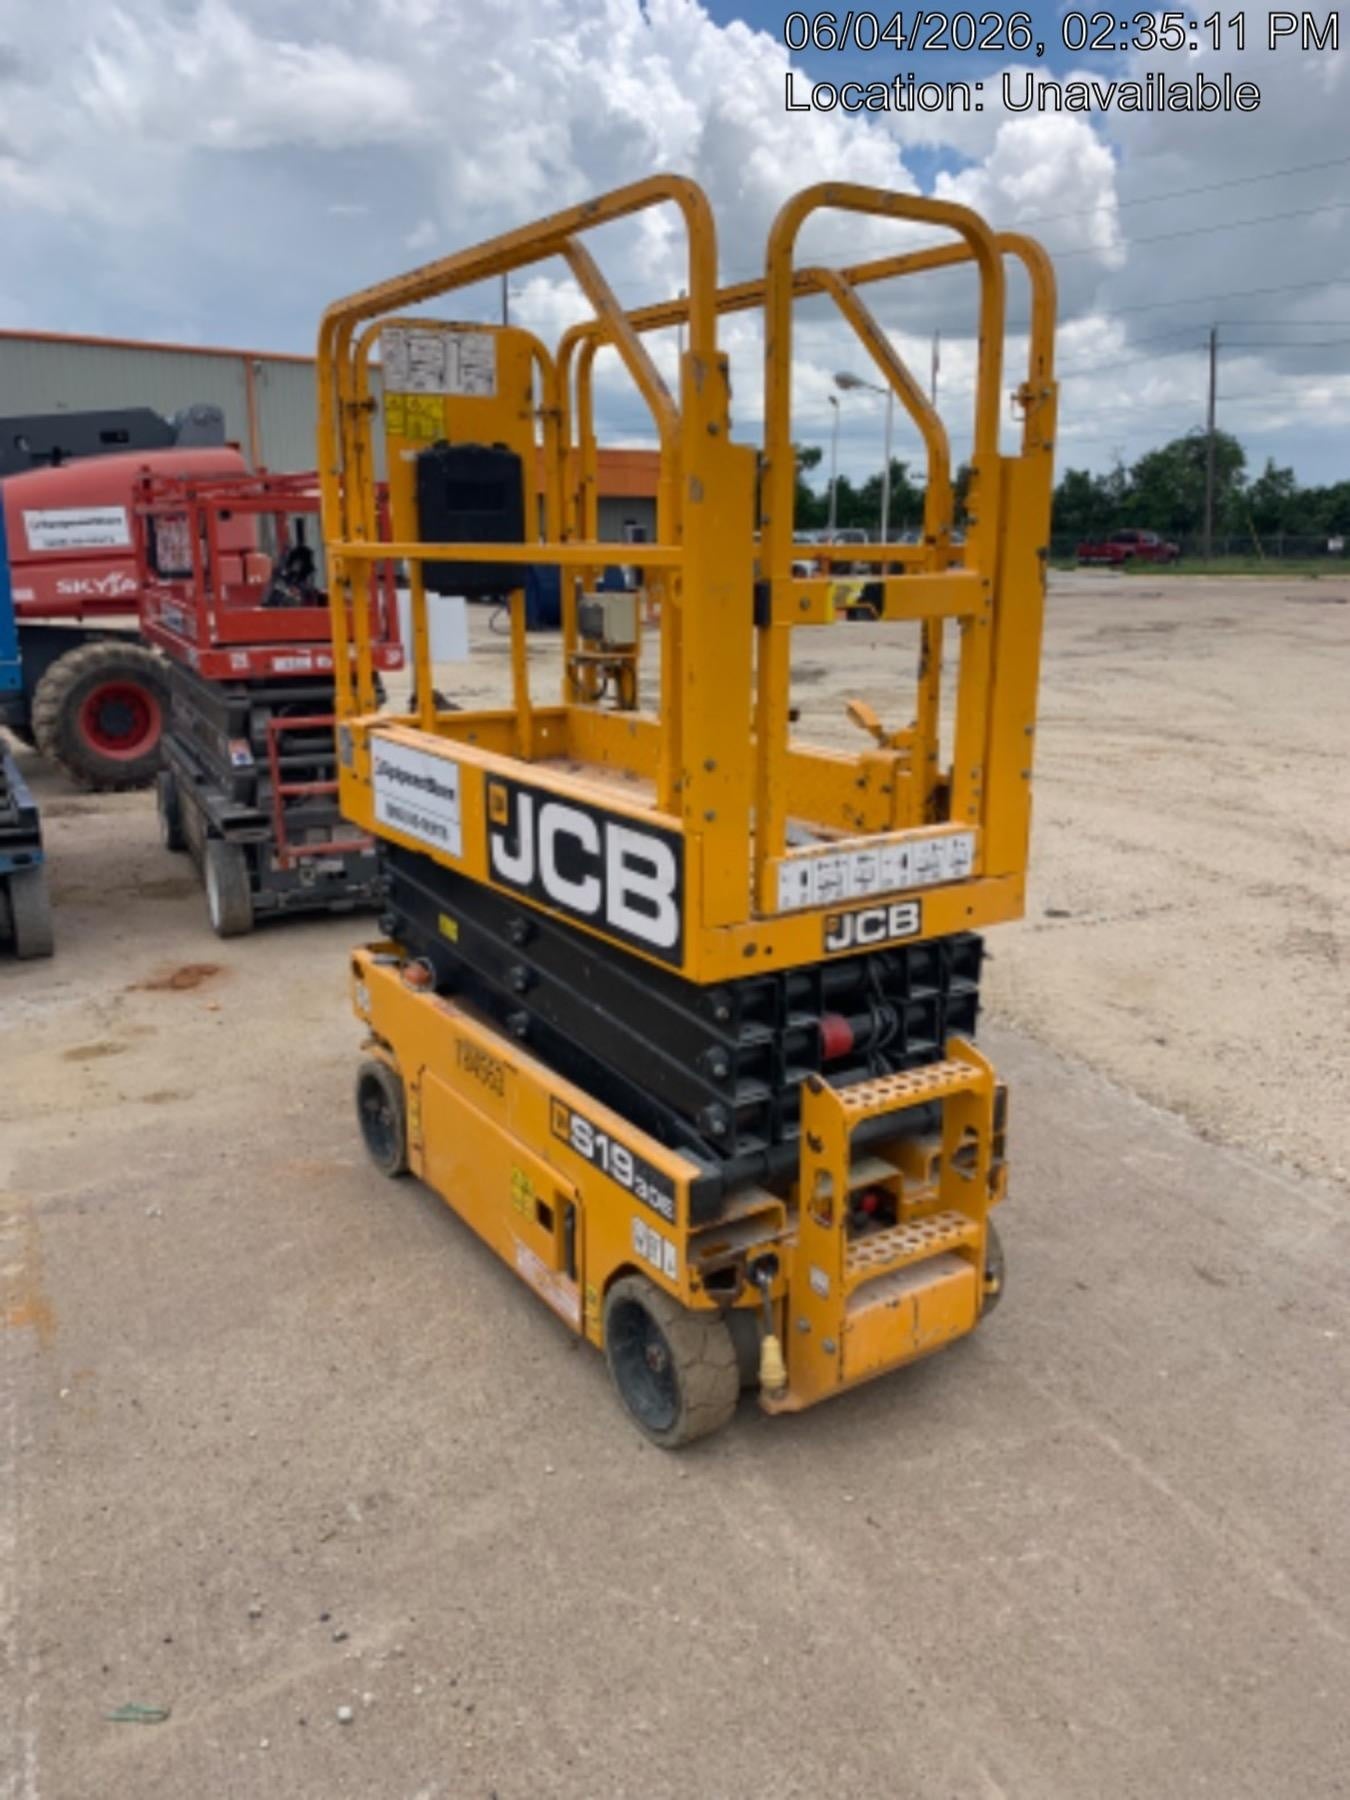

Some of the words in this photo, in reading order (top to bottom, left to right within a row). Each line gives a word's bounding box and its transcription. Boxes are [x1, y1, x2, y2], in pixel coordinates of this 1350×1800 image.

[56, 572, 137, 598] SKYJA
[491, 792, 680, 948] JCB
[826, 901, 921, 951] JCB
